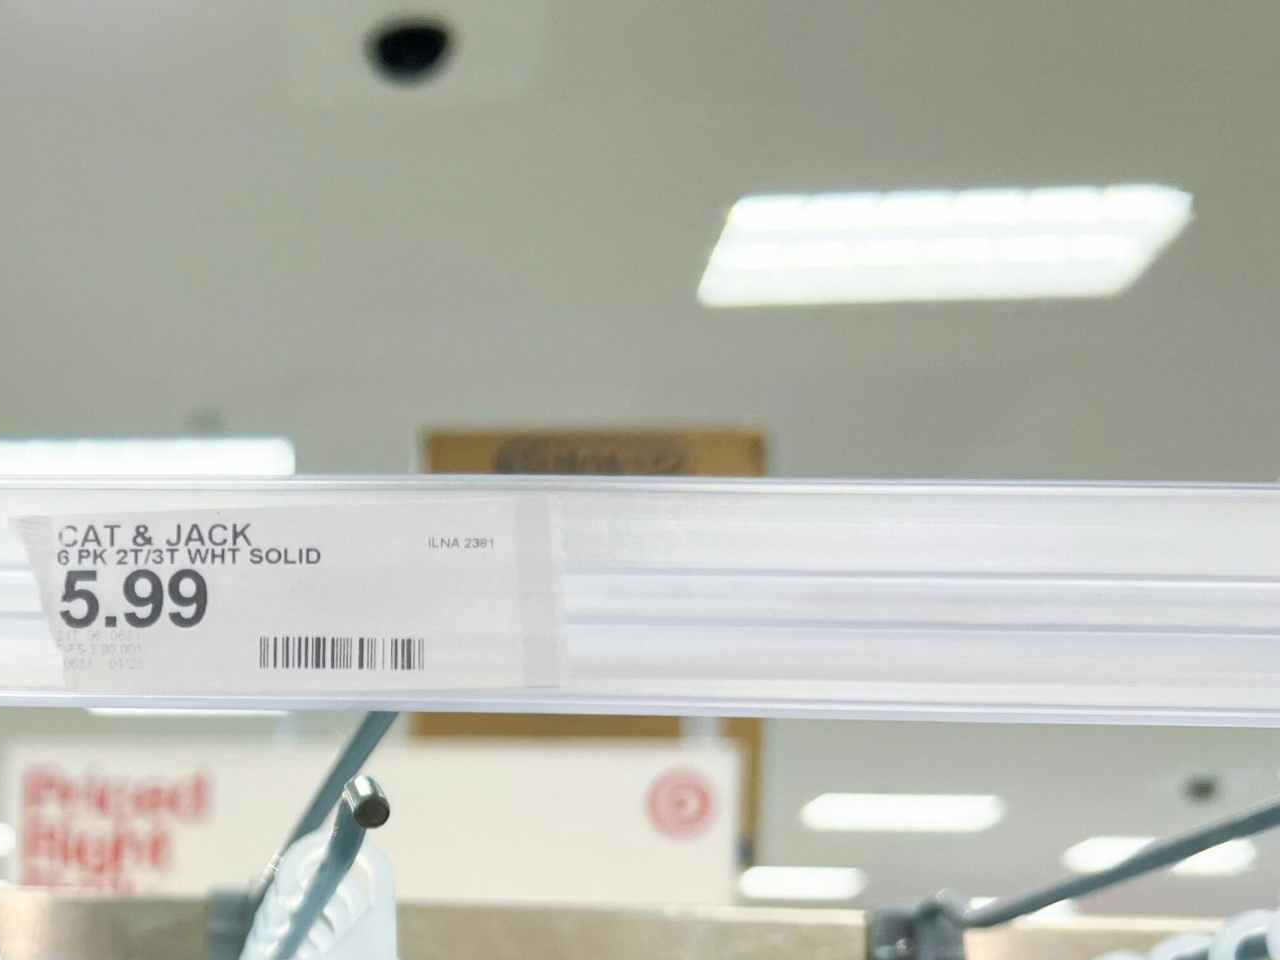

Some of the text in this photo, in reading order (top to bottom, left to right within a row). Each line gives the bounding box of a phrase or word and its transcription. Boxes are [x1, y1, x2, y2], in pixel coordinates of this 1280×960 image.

[58, 523, 253, 547] CAT & JACK
[57, 547, 322, 566] 6 PK 2T/3T WHT SOLID
[59, 568, 209, 630] 5.99
